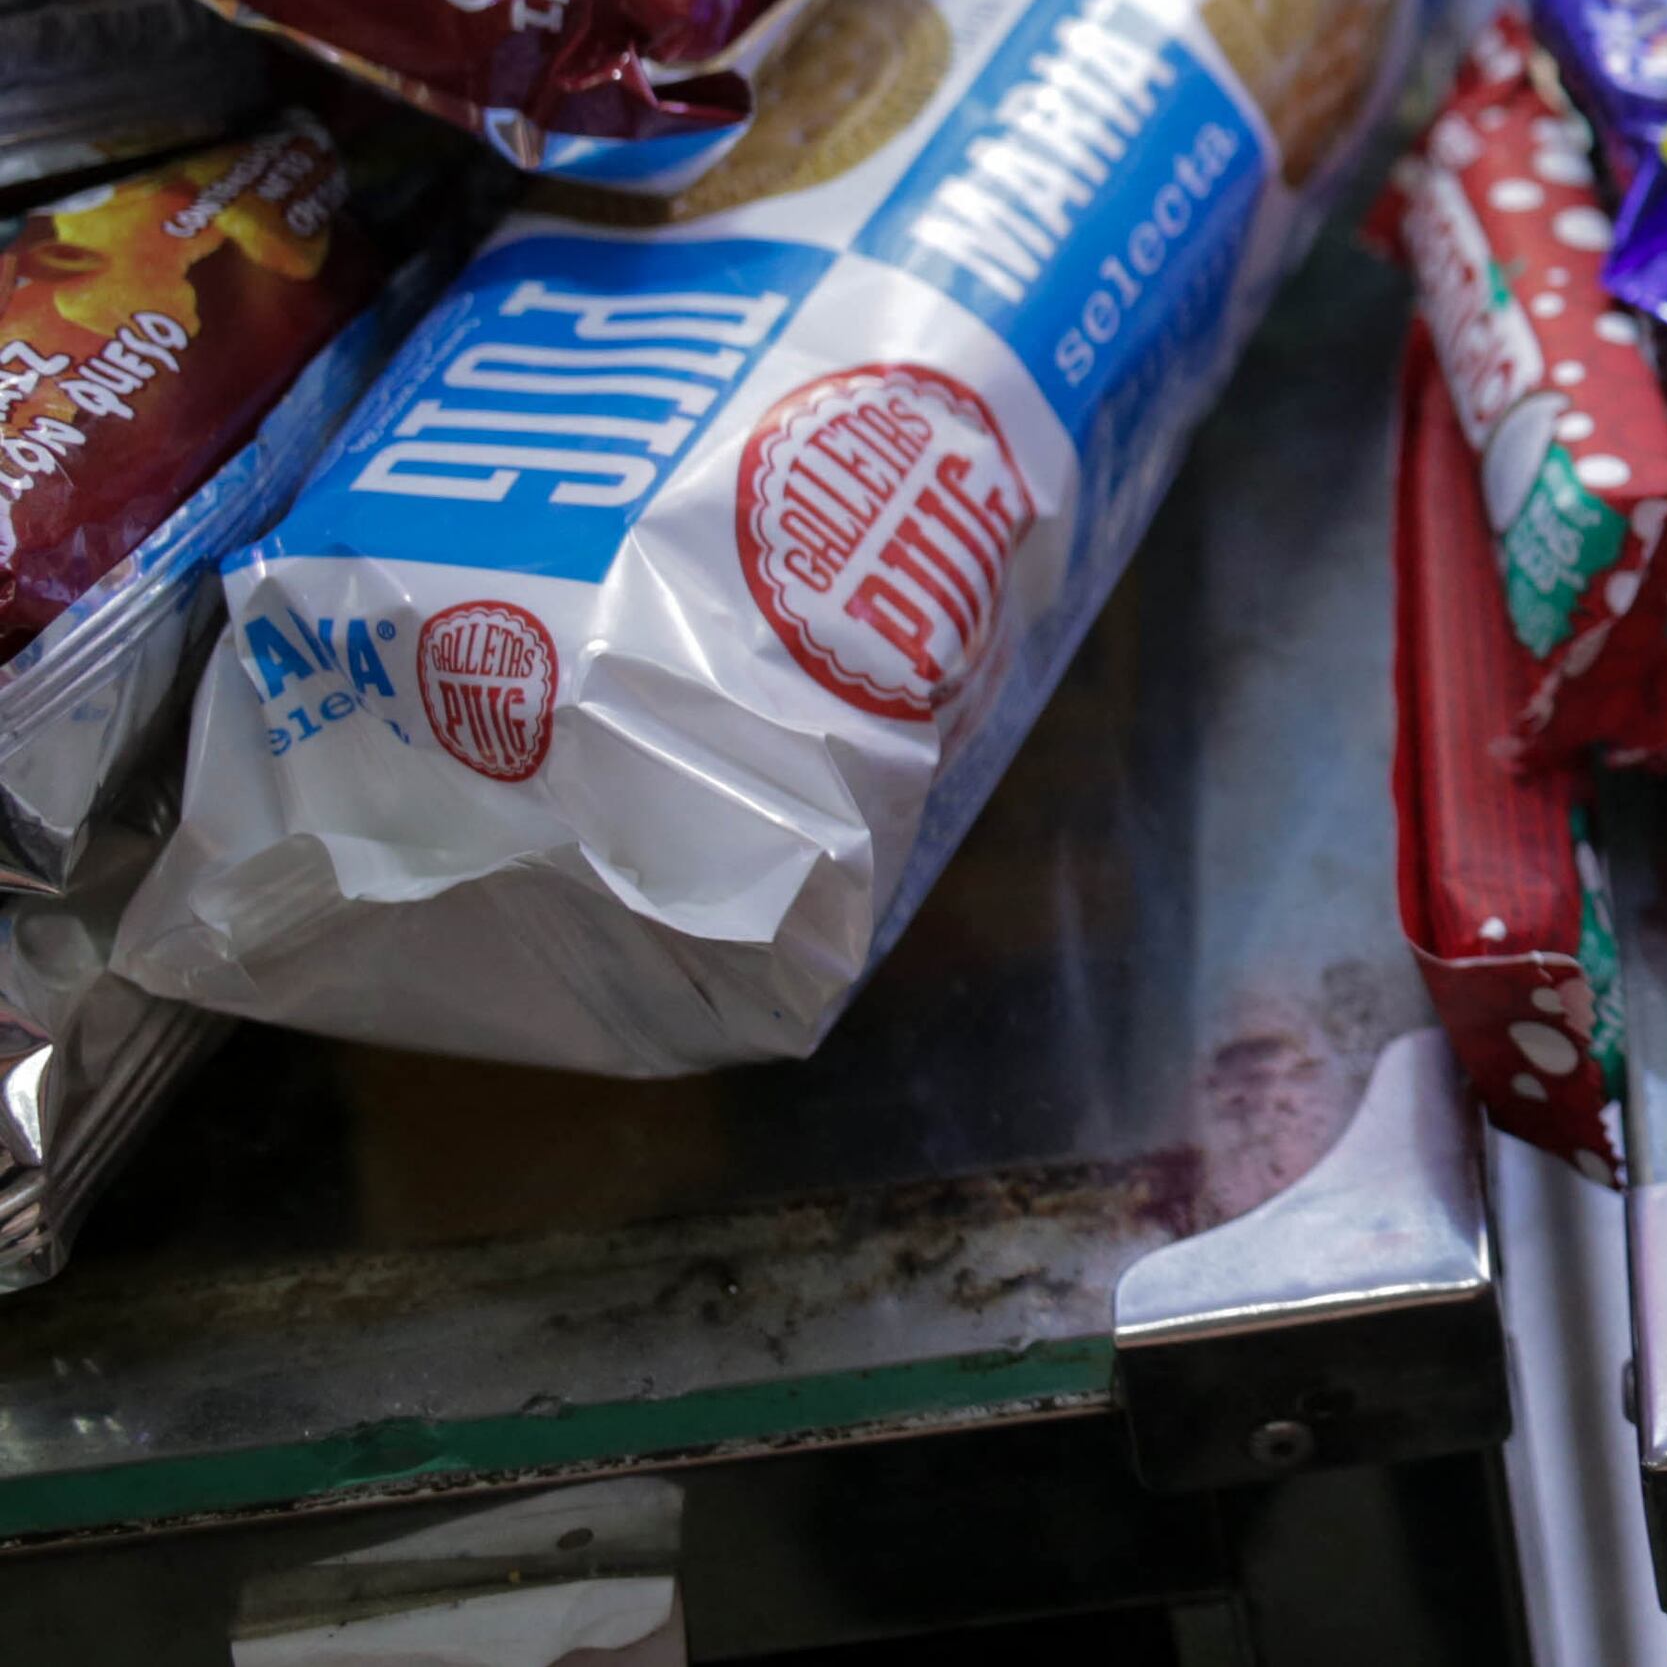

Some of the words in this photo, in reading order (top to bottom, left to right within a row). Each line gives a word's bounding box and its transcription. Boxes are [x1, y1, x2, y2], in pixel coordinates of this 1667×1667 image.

[1054, 120, 1240, 382] selecta
[57, 310, 189, 422] QUESO
[782, 398, 935, 594] GALLETAS
[842, 453, 1022, 682] PUIG
[431, 622, 536, 679] GALLETAS
[437, 680, 528, 766] PUIG
